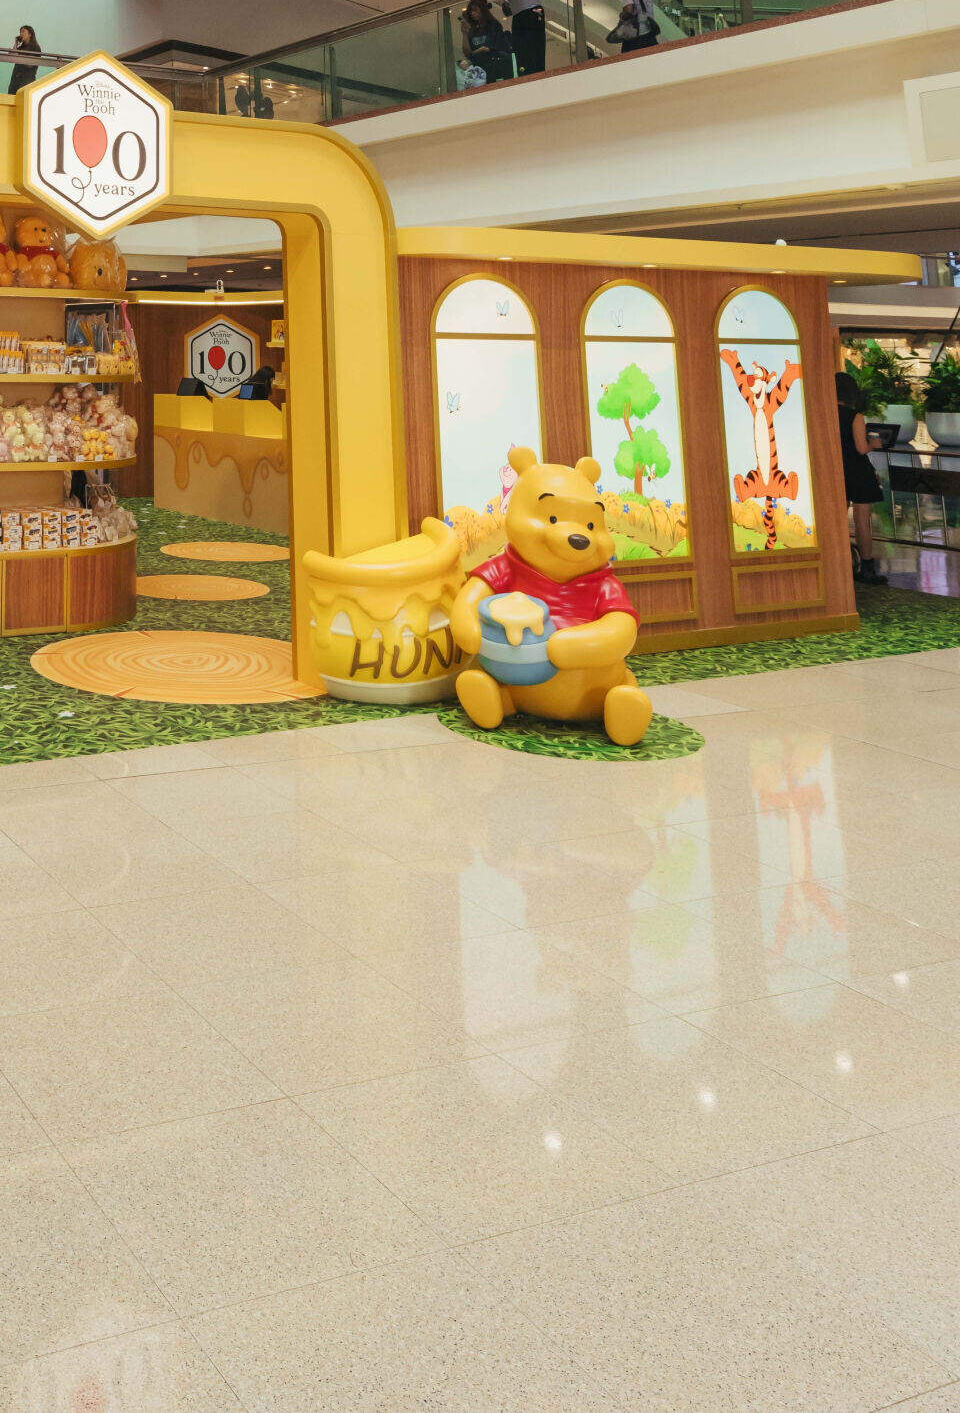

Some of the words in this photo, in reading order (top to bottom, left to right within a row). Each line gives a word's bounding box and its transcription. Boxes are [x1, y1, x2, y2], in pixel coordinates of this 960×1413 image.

[76, 83, 121, 101] Winnie
[84, 98, 116, 116] Pooh
[94, 182, 135, 197] years
[219, 376, 241, 384] years
